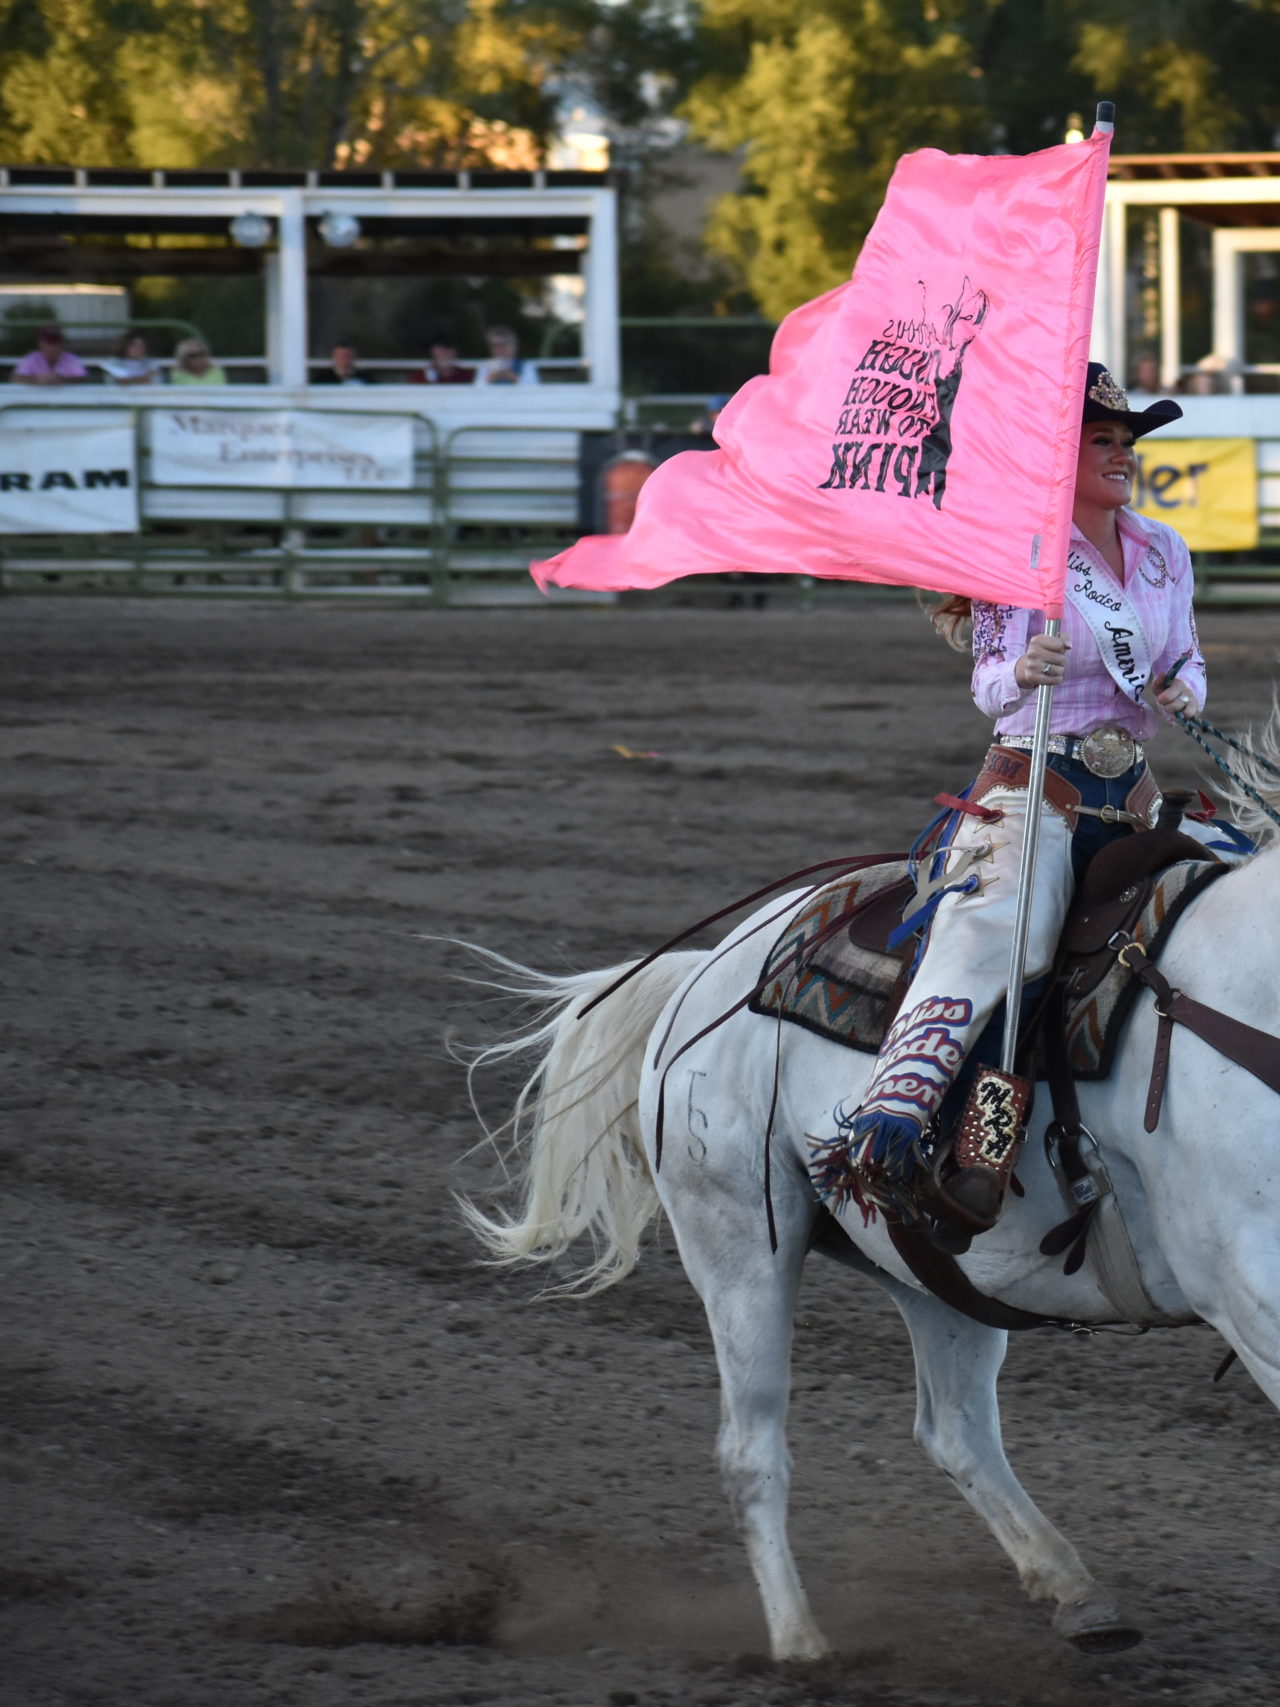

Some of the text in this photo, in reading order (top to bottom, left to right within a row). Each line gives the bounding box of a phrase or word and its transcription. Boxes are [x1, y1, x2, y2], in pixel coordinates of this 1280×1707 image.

[0, 469, 129, 491] RAM
[1073, 578, 1122, 612] Rodeo
[1103, 620, 1146, 704] Americ
